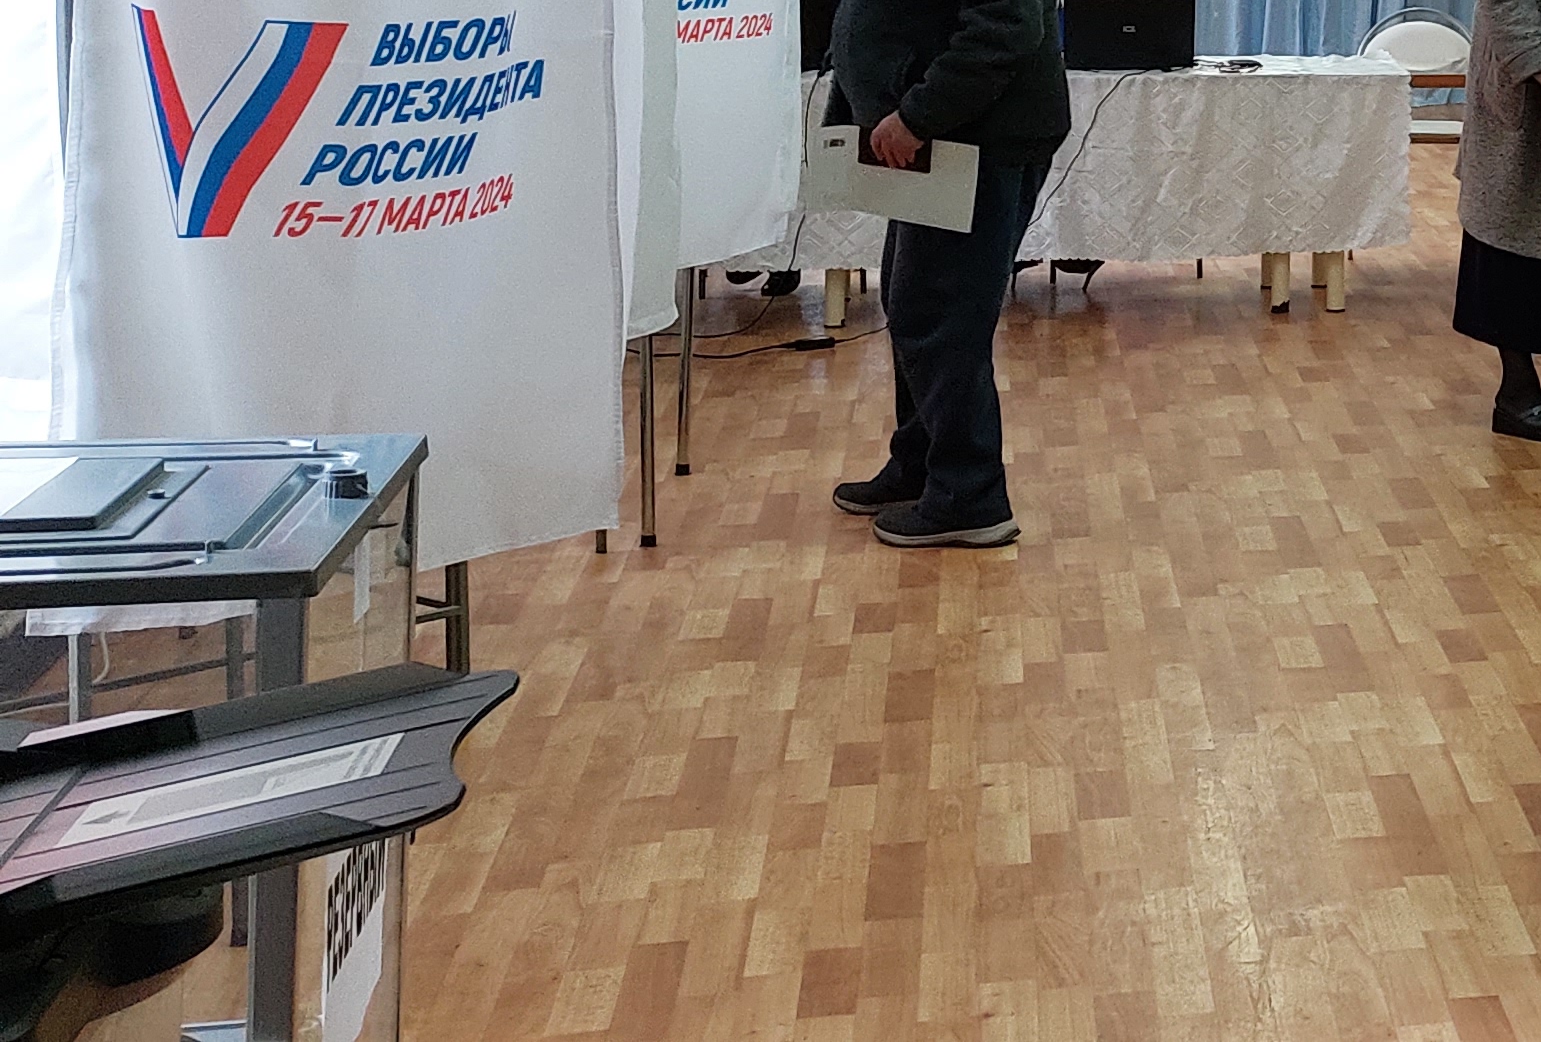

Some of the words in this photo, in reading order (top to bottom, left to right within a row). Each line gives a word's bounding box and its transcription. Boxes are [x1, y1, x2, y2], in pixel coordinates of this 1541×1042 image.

[370, 10, 517, 68] ВЫБОРЫ
[735, 12, 774, 40] 2024
[335, 59, 545, 127] ПРЕЗИДЕНТА
[300, 132, 479, 187] РОССИИ
[376, 186, 471, 237] МАРТА
[469, 173, 514, 221] 2024
